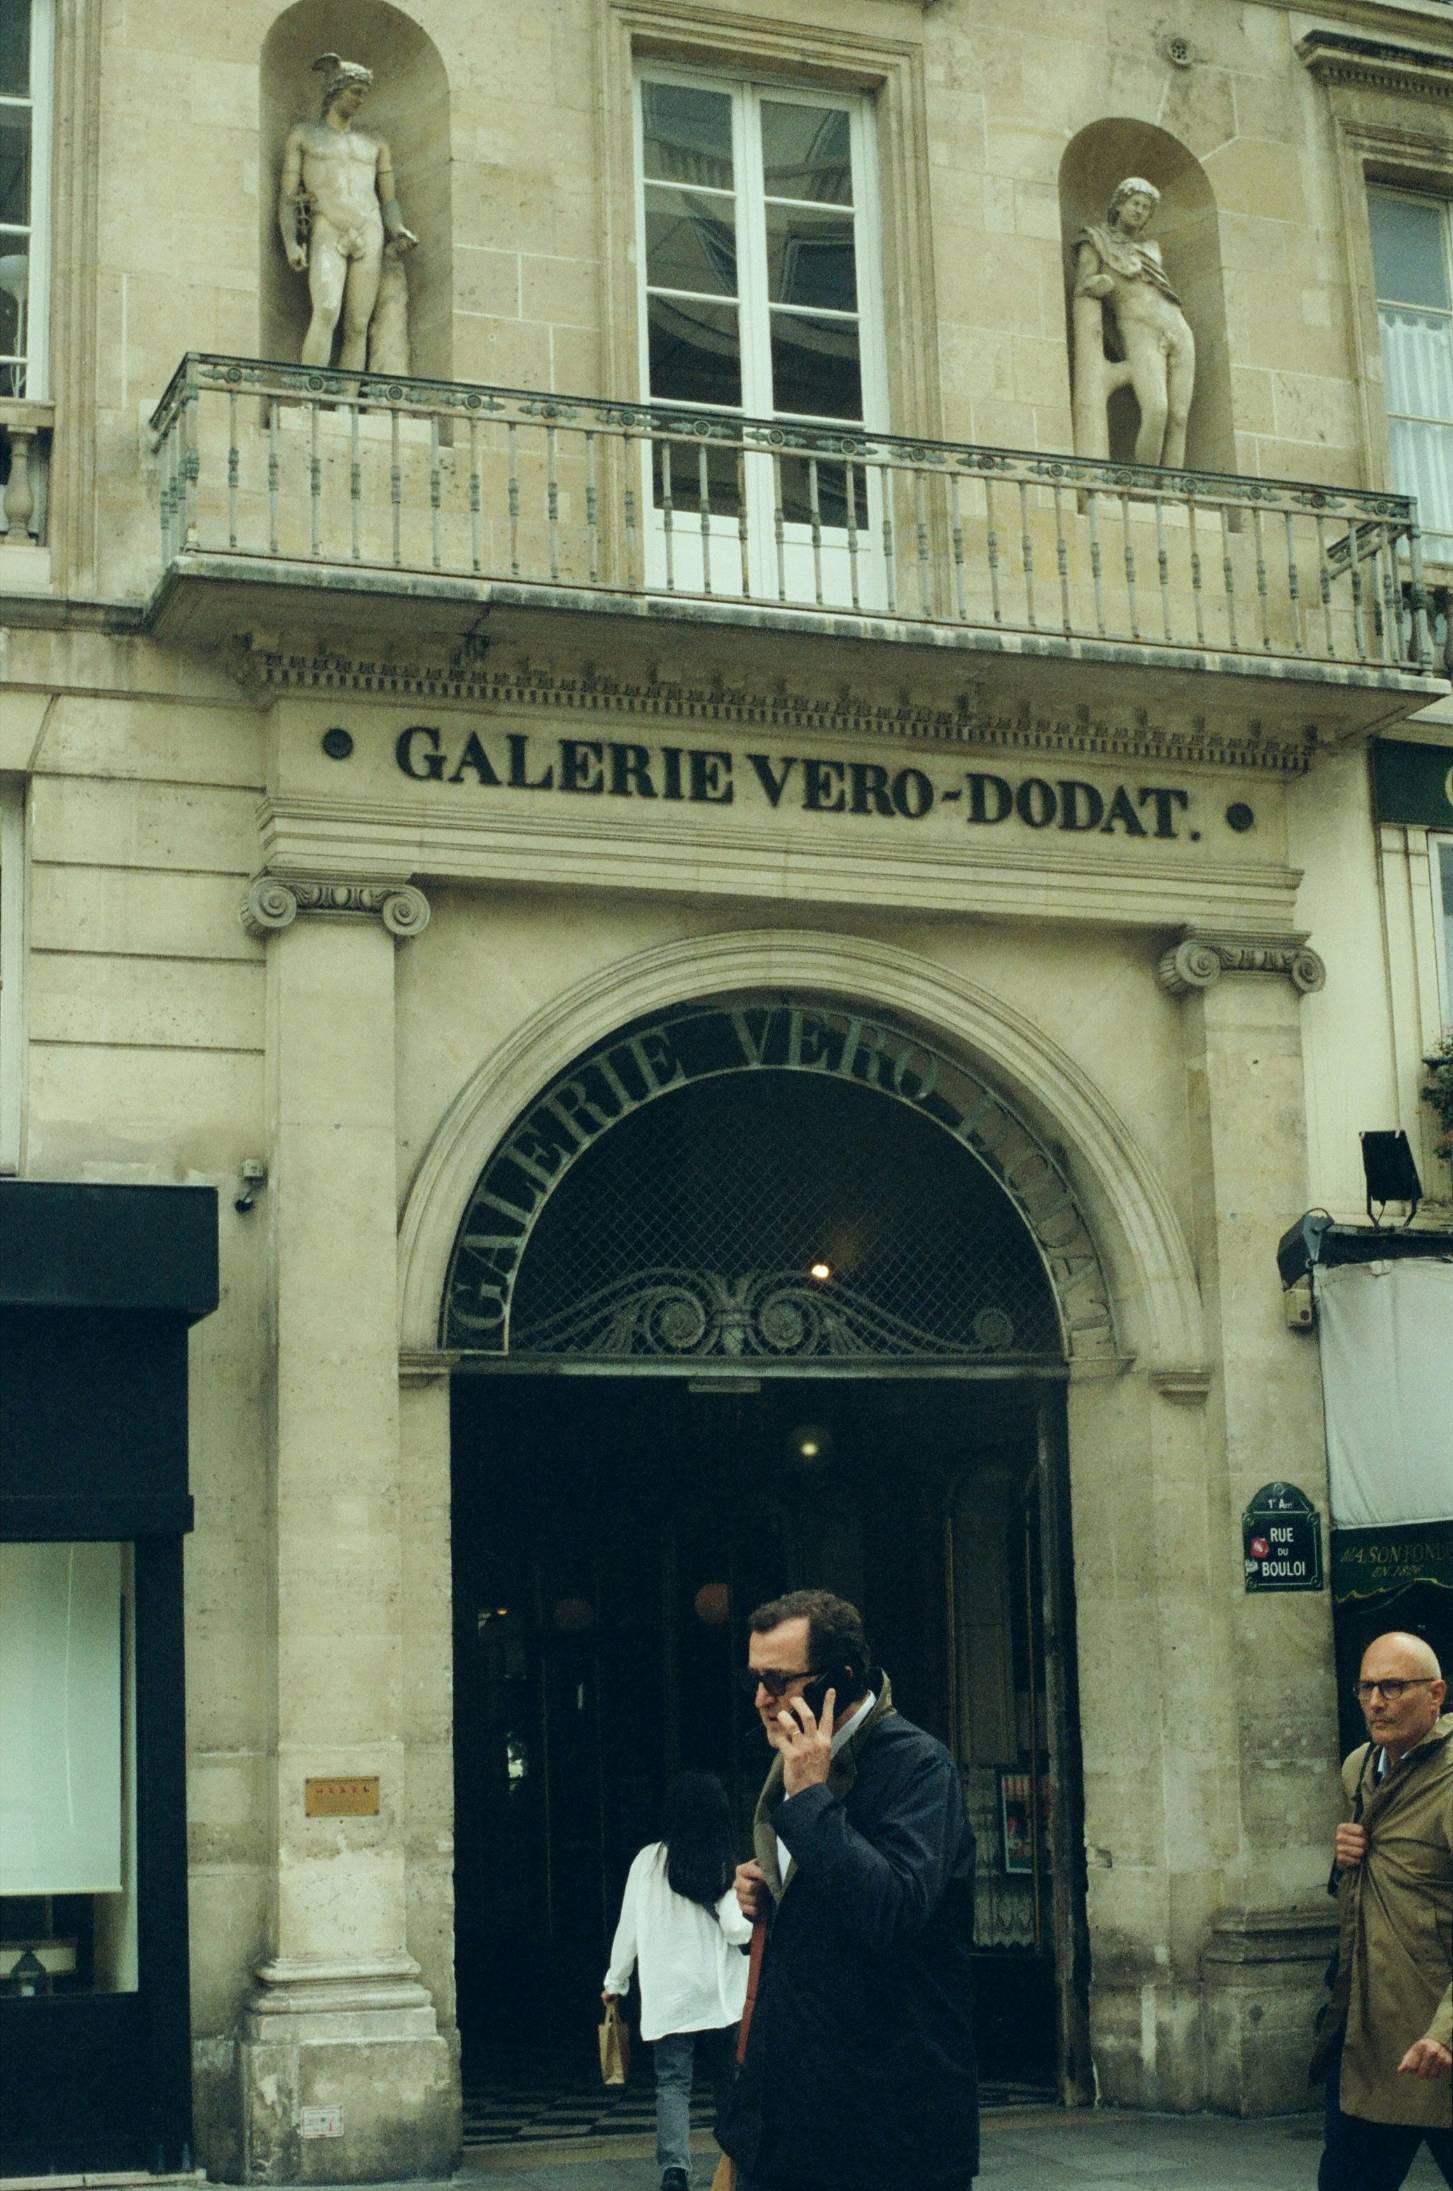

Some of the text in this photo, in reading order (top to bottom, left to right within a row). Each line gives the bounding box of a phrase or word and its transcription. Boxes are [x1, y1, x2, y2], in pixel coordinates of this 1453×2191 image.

[394, 725, 1202, 842] GALERIE VERO-DODAT.
[451, 1025, 688, 1331] GALERIE
[728, 1007, 938, 1100] VERO
[1269, 1527, 1294, 1542] RUE
[1277, 1547, 1289, 1556] DU
[1261, 1561, 1306, 1577] BOULOI
